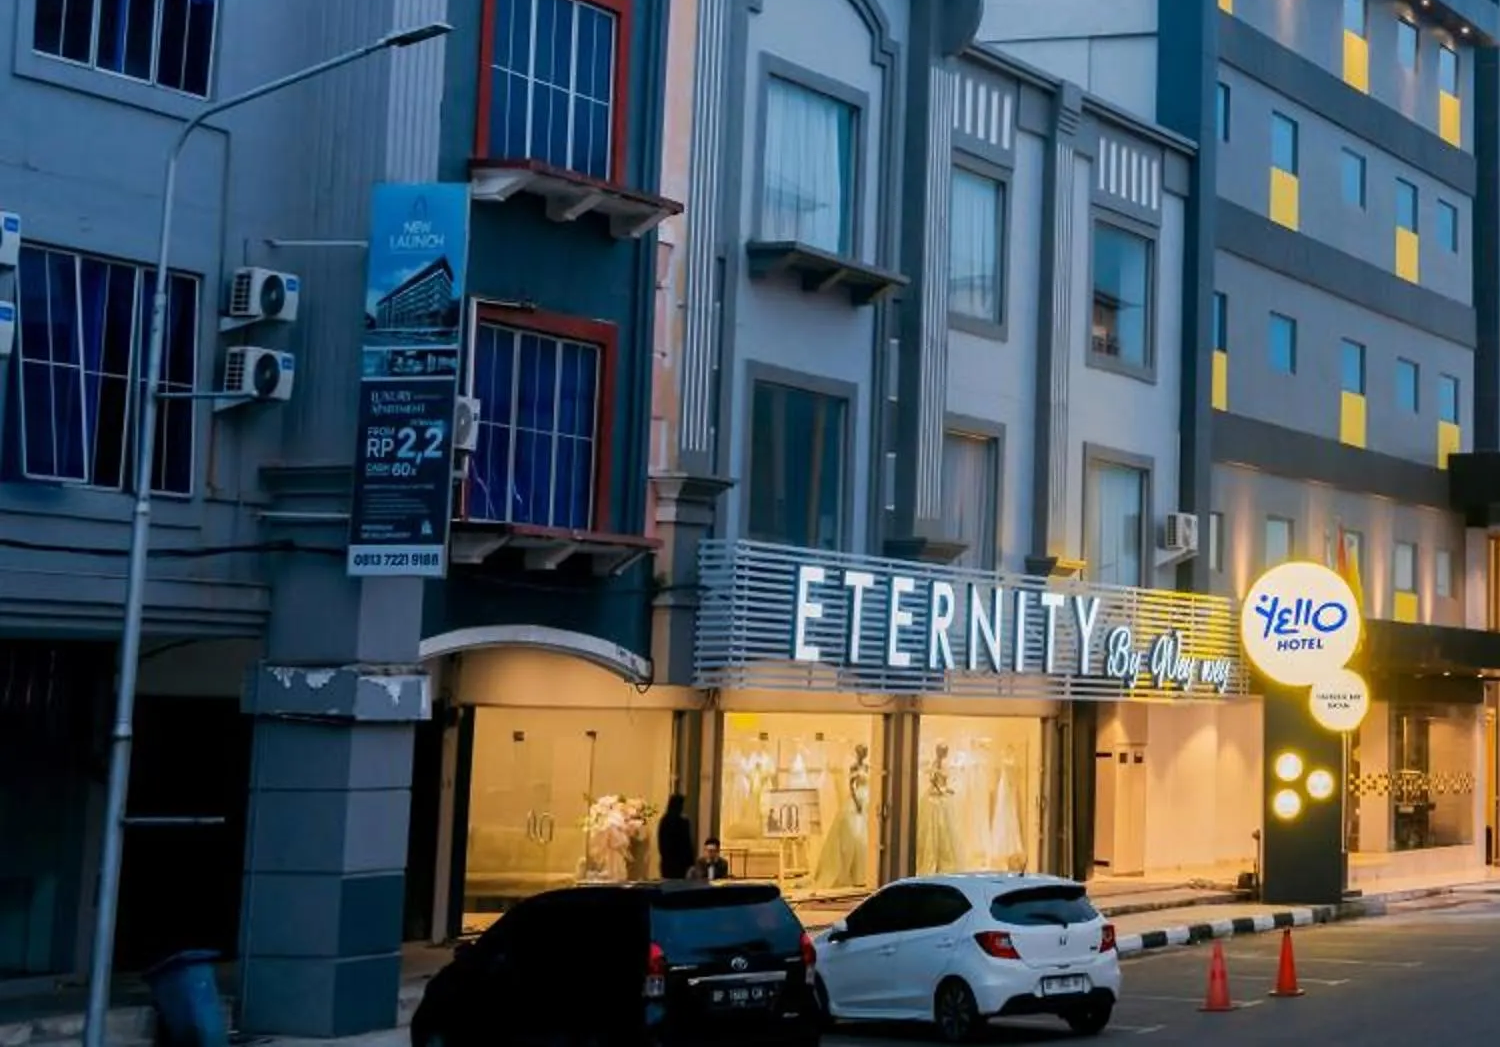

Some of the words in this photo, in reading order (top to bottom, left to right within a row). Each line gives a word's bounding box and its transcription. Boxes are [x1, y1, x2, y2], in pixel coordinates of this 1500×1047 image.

[403, 220, 432, 234] NEW
[389, 234, 445, 250] LAUNCH
[367, 438, 395, 458] RP
[397, 426, 443, 465] 2,2
[794, 566, 1099, 676] ETERNITY
[1107, 626, 1141, 688] By
[1276, 639, 1325, 651] HOTEL
